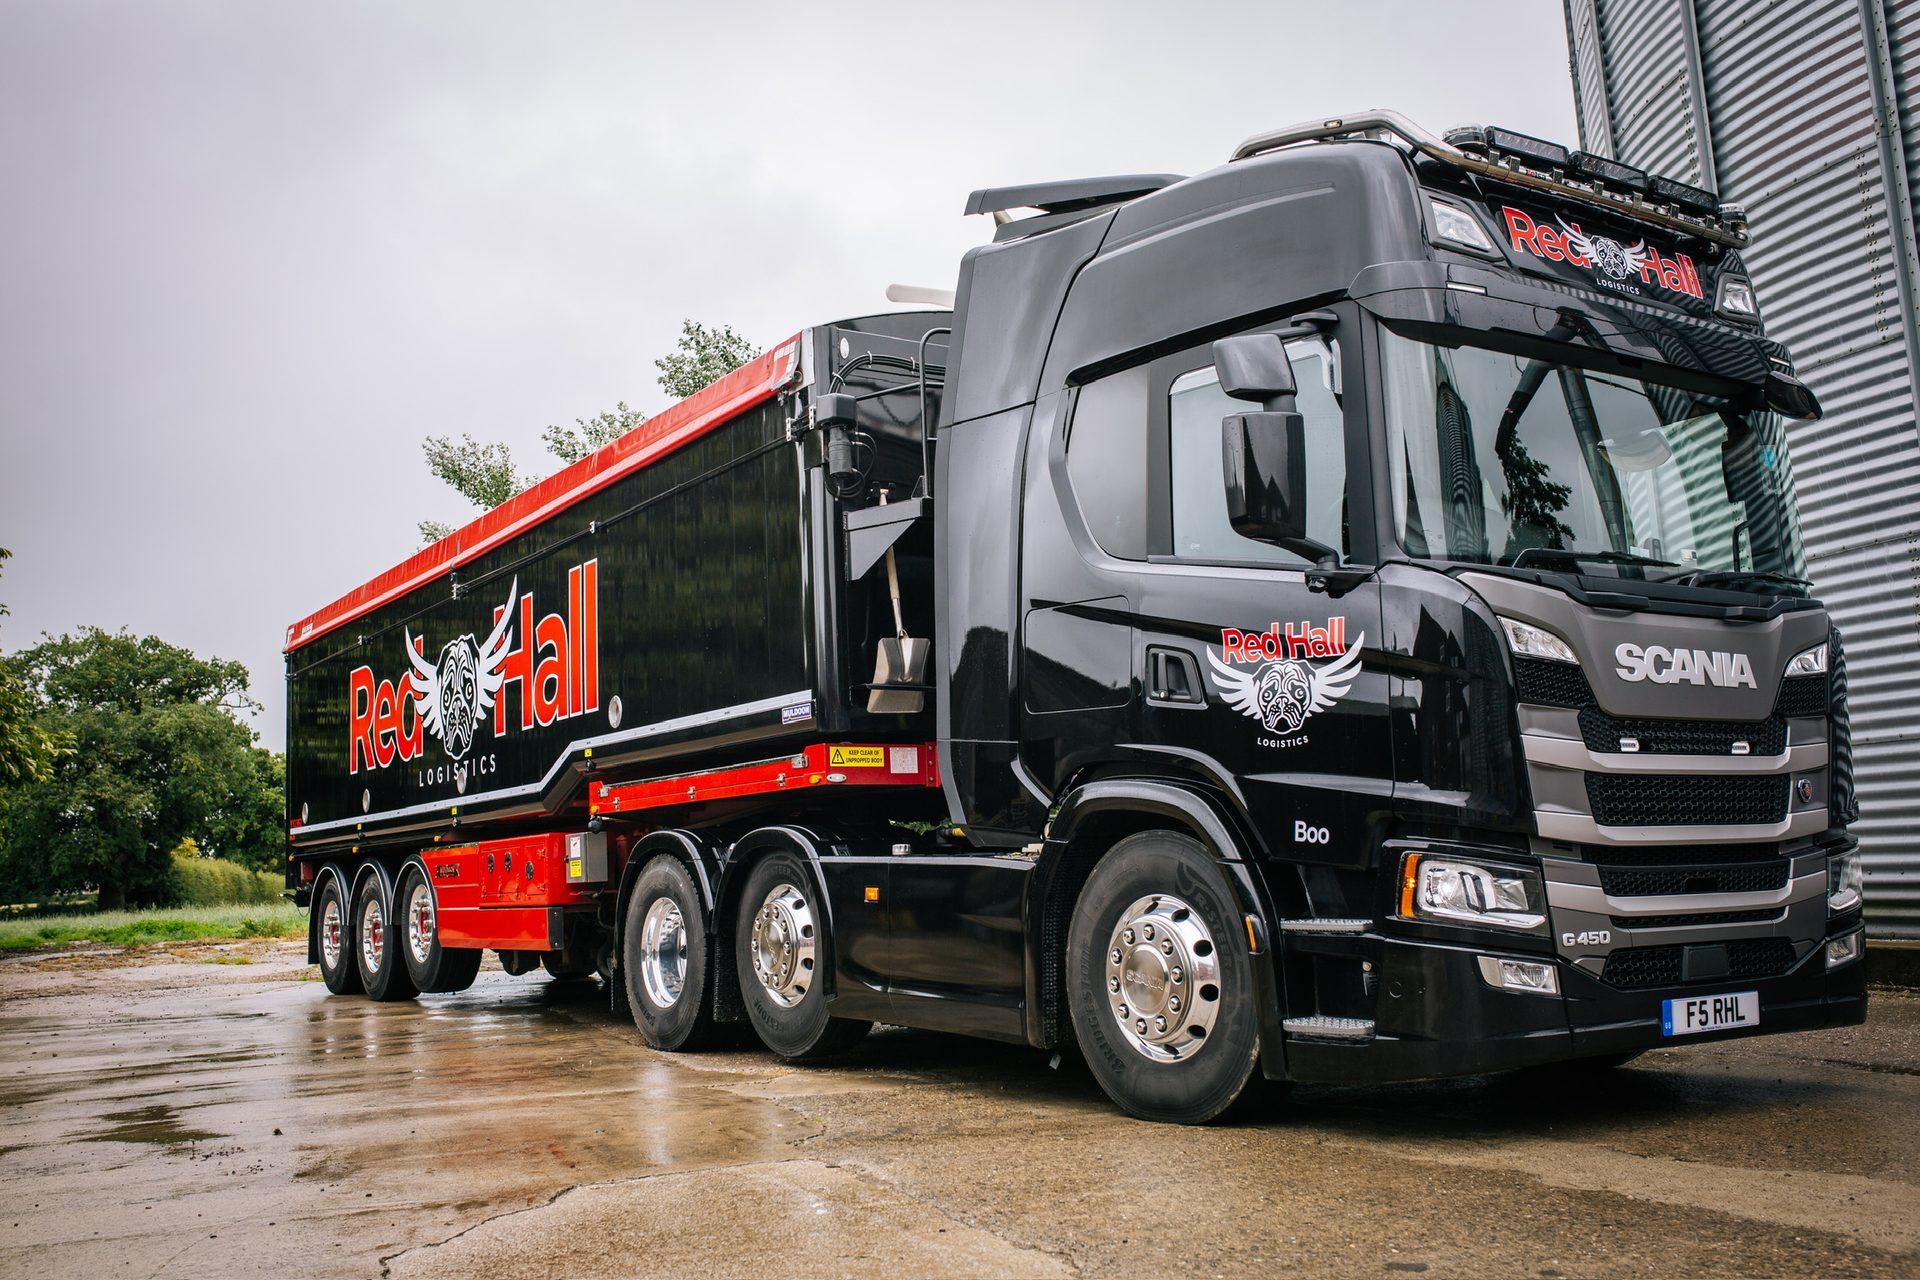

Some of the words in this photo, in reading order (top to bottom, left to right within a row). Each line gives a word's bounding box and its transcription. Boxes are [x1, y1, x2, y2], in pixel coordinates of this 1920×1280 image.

[1502, 206, 1592, 269] Red
[1632, 240, 1703, 300] Hall
[1596, 278, 1640, 296] LOGISTICS
[1221, 622, 1283, 664] Red
[1285, 616, 1346, 659] Hall
[350, 634, 424, 775] Red
[494, 557, 599, 738] Hall
[1615, 642, 1758, 689] SCANIA
[783, 704, 810, 718] MULDOON
[1257, 735, 1309, 748] LOGISTICS
[418, 753, 496, 787] LOGISTICS
[1294, 820, 1330, 844] Boo
[1687, 1001, 1709, 1028] F5
[1713, 996, 1746, 1025] RHL
